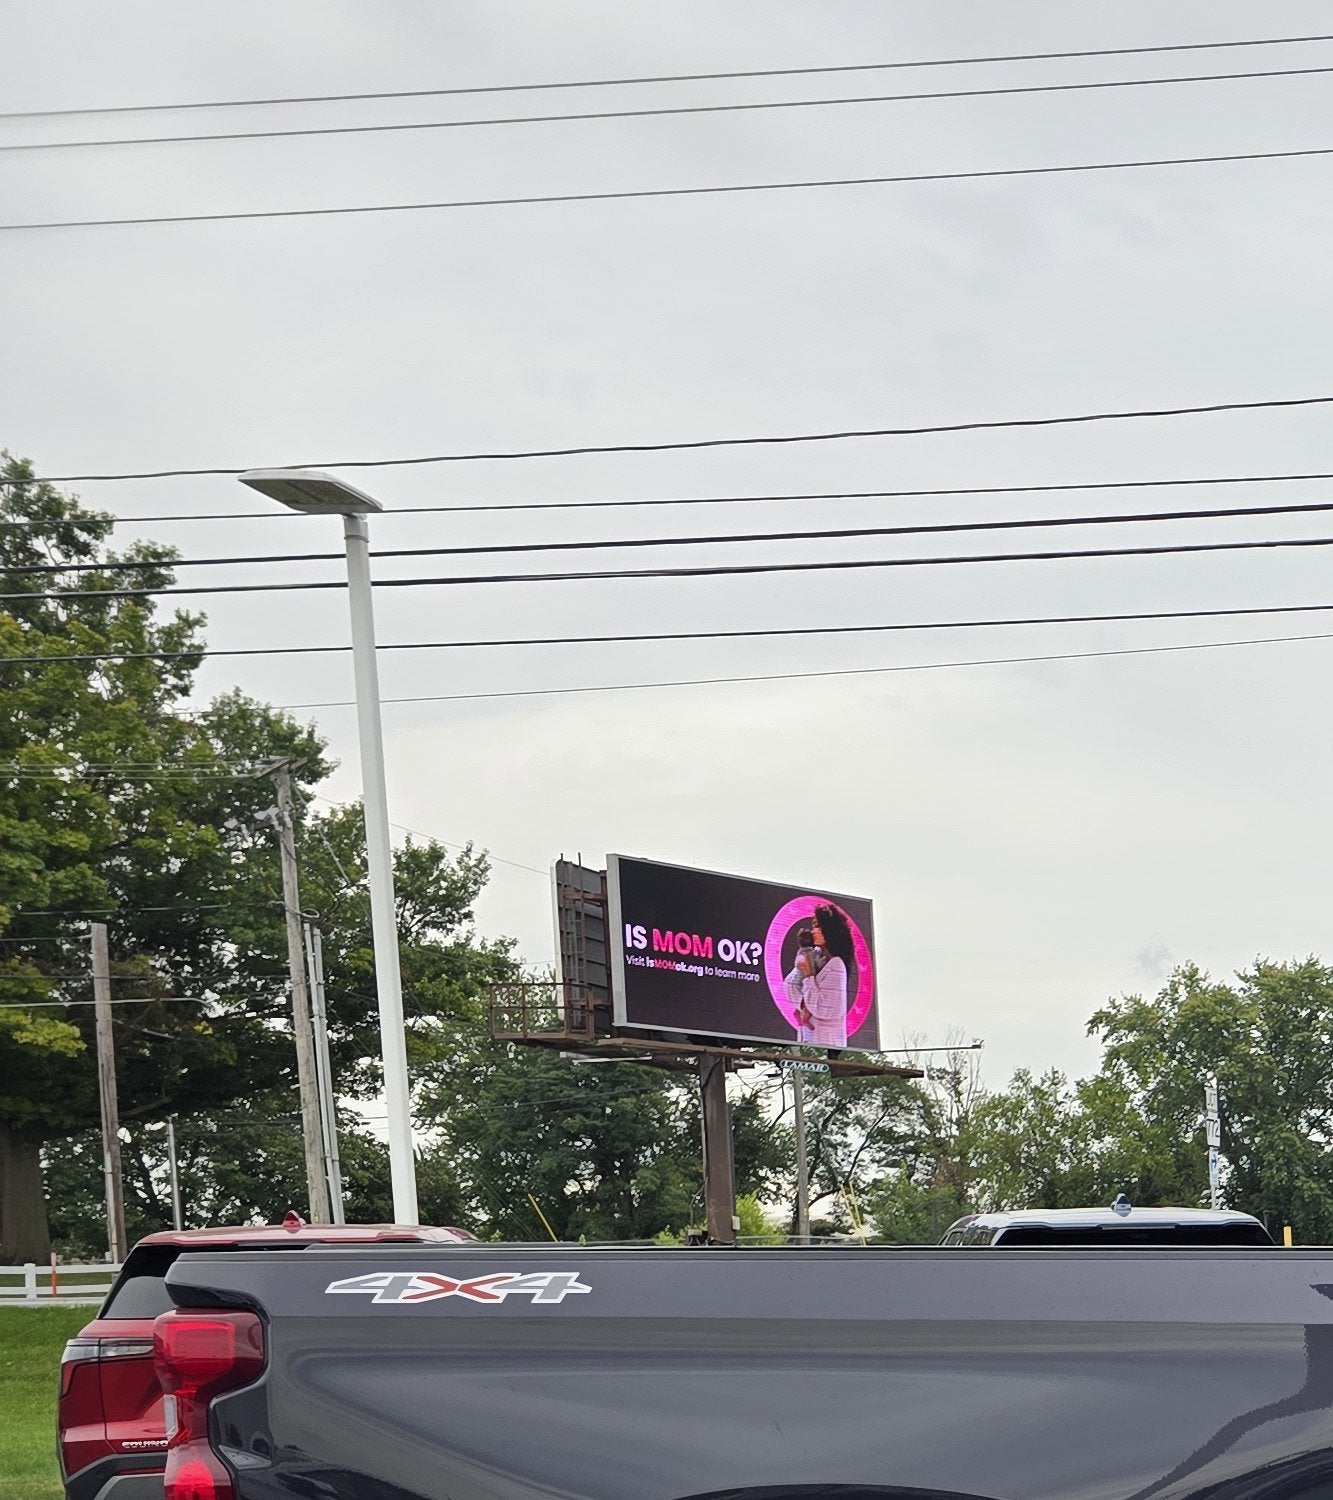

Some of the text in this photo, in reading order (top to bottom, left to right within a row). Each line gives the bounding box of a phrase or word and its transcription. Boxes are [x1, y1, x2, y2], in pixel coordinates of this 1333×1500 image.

[625, 923, 763, 966] IS MOM OK?
[625, 955, 760, 982] Visit isMOMok.org to learn more
